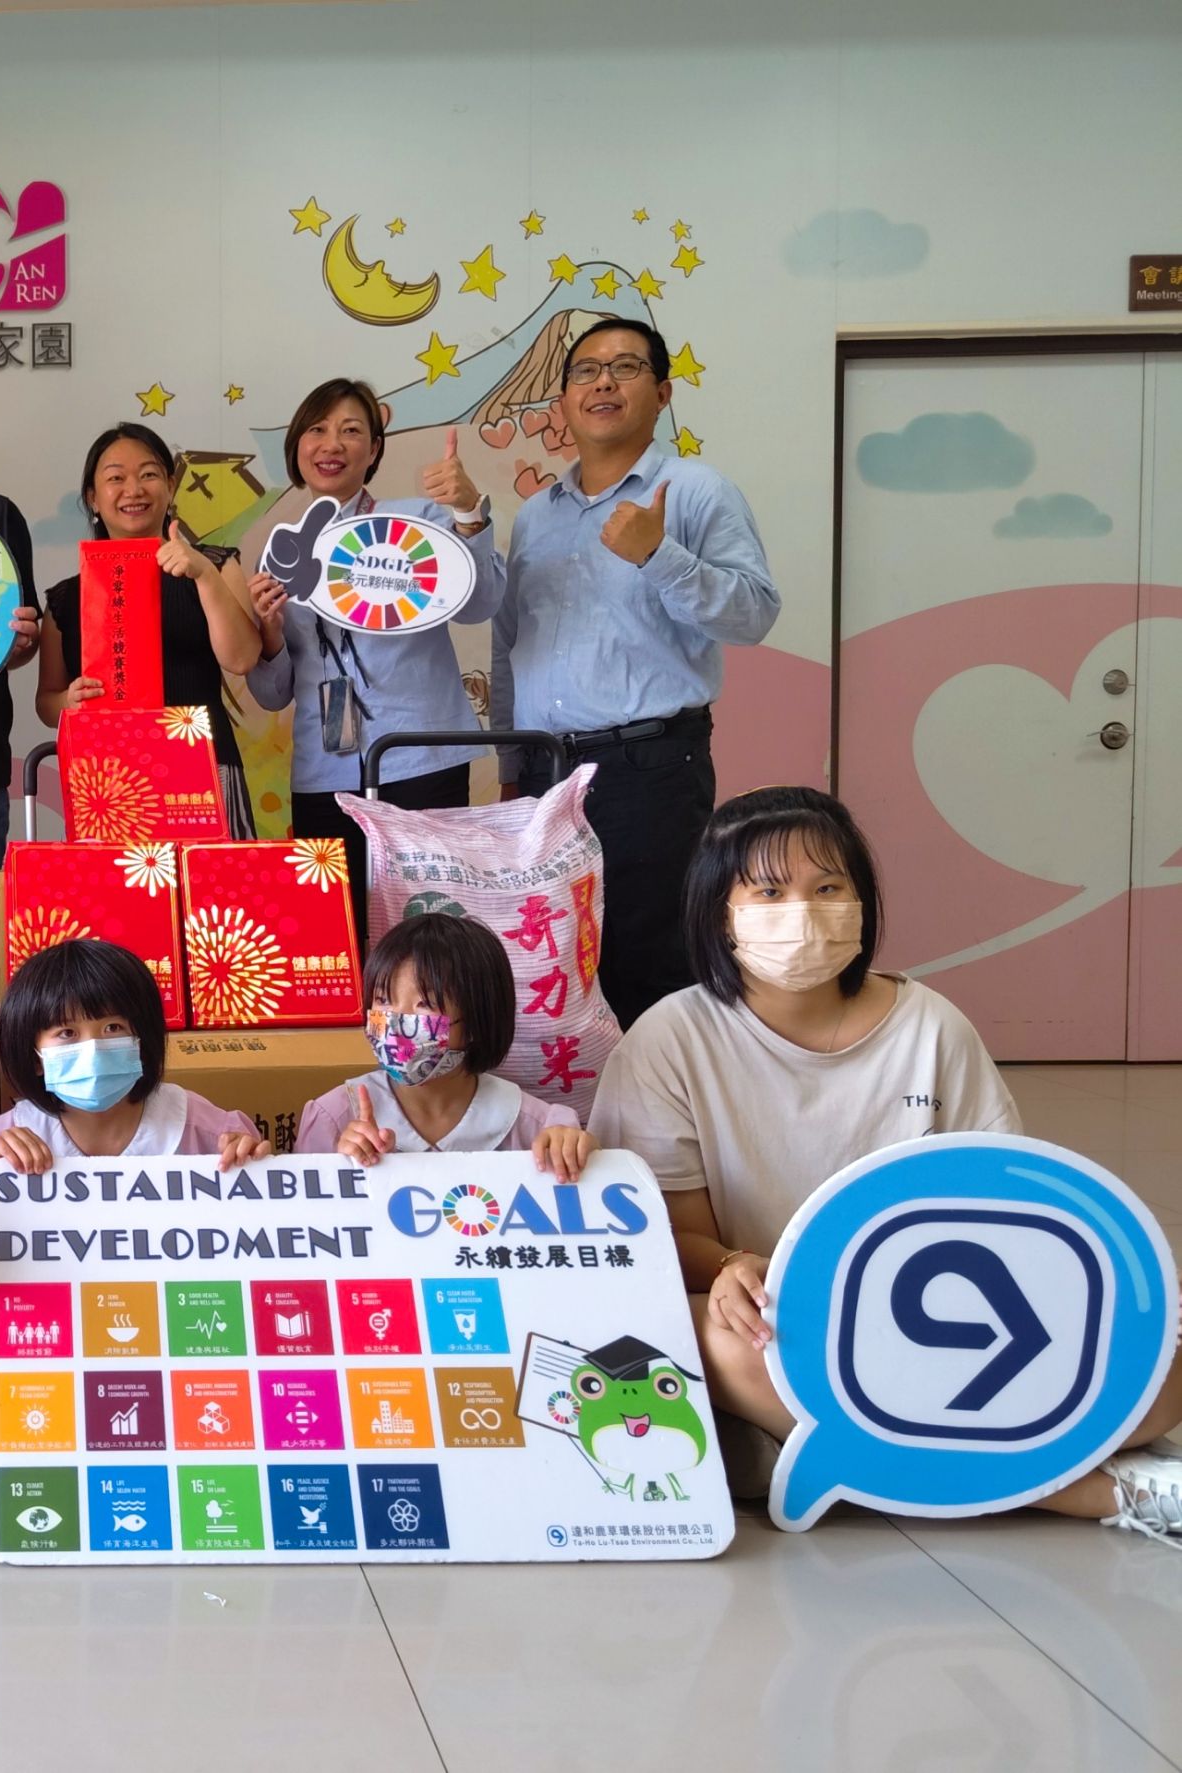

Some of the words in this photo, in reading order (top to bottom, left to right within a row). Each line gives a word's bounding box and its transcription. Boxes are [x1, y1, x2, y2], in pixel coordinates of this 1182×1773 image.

[14, 261, 45, 280] AN
[16, 284, 56, 303] REN
[354, 555, 415, 575] SDG17
[292, 951, 350, 971] 健康廚房
[388, 1183, 648, 1238] GOALS
[455, 1244, 635, 1270] 永續發展目標
[97, 1294, 104, 1307] 2
[178, 1293, 186, 1306] 3
[265, 1293, 272, 1305] 4
[352, 1293, 359, 1305] 5
[436, 1291, 444, 1303] 6
[4, 1297, 10, 1311] 1
[9, 1386, 16, 1398] 7
[98, 1385, 105, 1397] 8
[185, 1384, 192, 1396] 9
[272, 1383, 284, 1397] 10
[360, 1382, 371, 1394] 11
[447, 1383, 461, 1396] 12
[10, 1483, 23, 1496] 13
[101, 1480, 113, 1493] 14
[191, 1480, 204, 1493] 15
[281, 1478, 294, 1492] 16
[372, 1478, 383, 1492] 17
[631, 1538, 681, 1546] Environment
